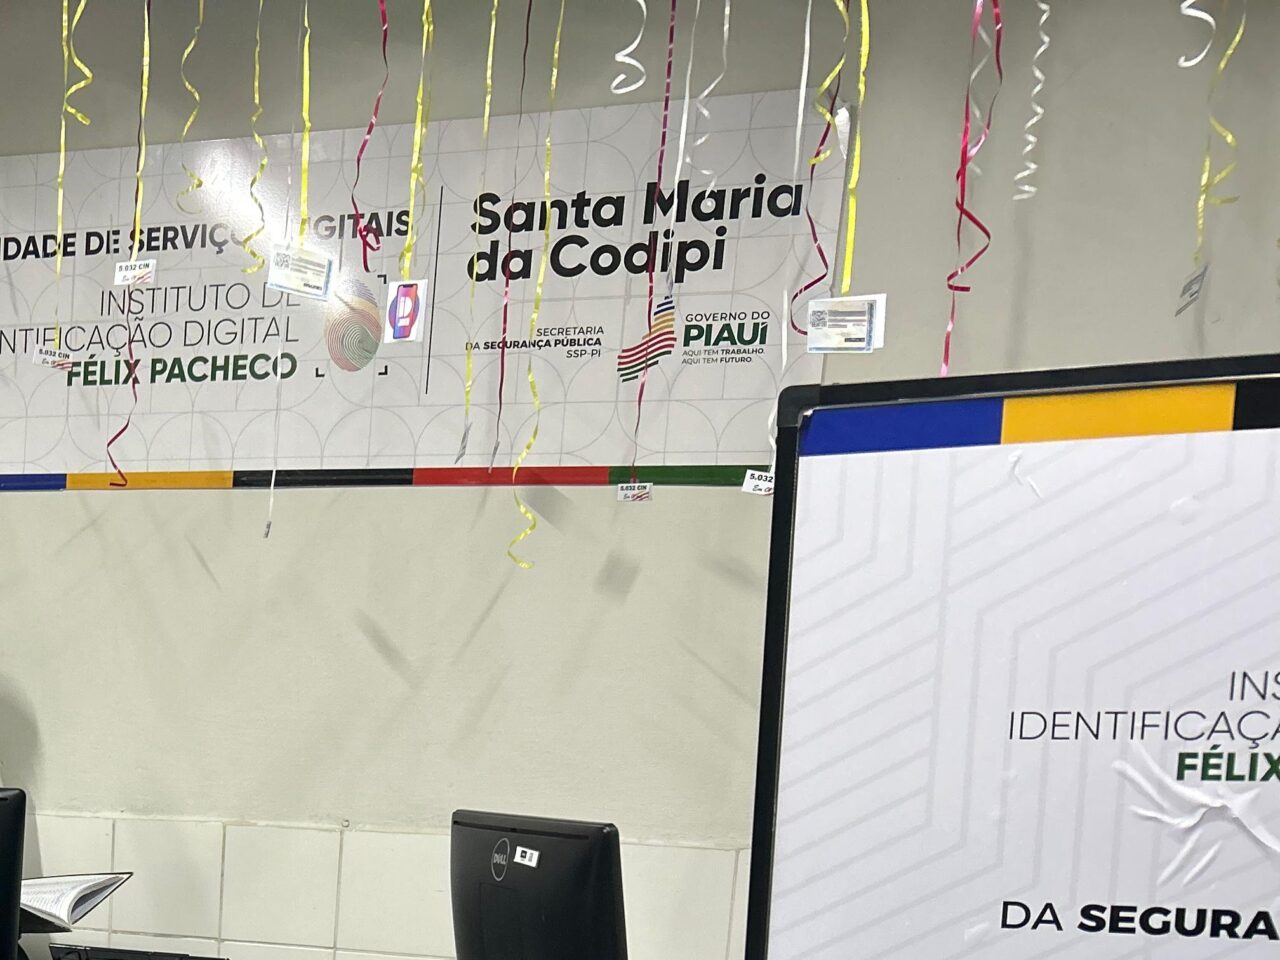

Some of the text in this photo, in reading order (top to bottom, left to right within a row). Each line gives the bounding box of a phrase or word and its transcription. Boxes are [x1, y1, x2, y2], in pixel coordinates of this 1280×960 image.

[469, 173, 804, 235] Santa Maria
[85, 230, 120, 256] DE
[466, 227, 728, 284] da Codipi
[101, 283, 250, 316] INSTITUTO
[685, 311, 770, 322] GOVERNO DO
[184, 316, 299, 347] DIGITAL
[465, 336, 602, 351] DA SEGURANÇA PÚBLICA
[536, 326, 605, 337] SECRETARIA
[683, 321, 768, 348] PIAUÍ
[566, 349, 601, 359] SSP-PI
[682, 349, 700, 357] AQUI
[682, 357, 700, 365] AQUI
[66, 352, 298, 387] FÉLIX PACHECO
[749, 473, 774, 483] 5.032
[1000, 901, 1280, 941] DA SEGURA
